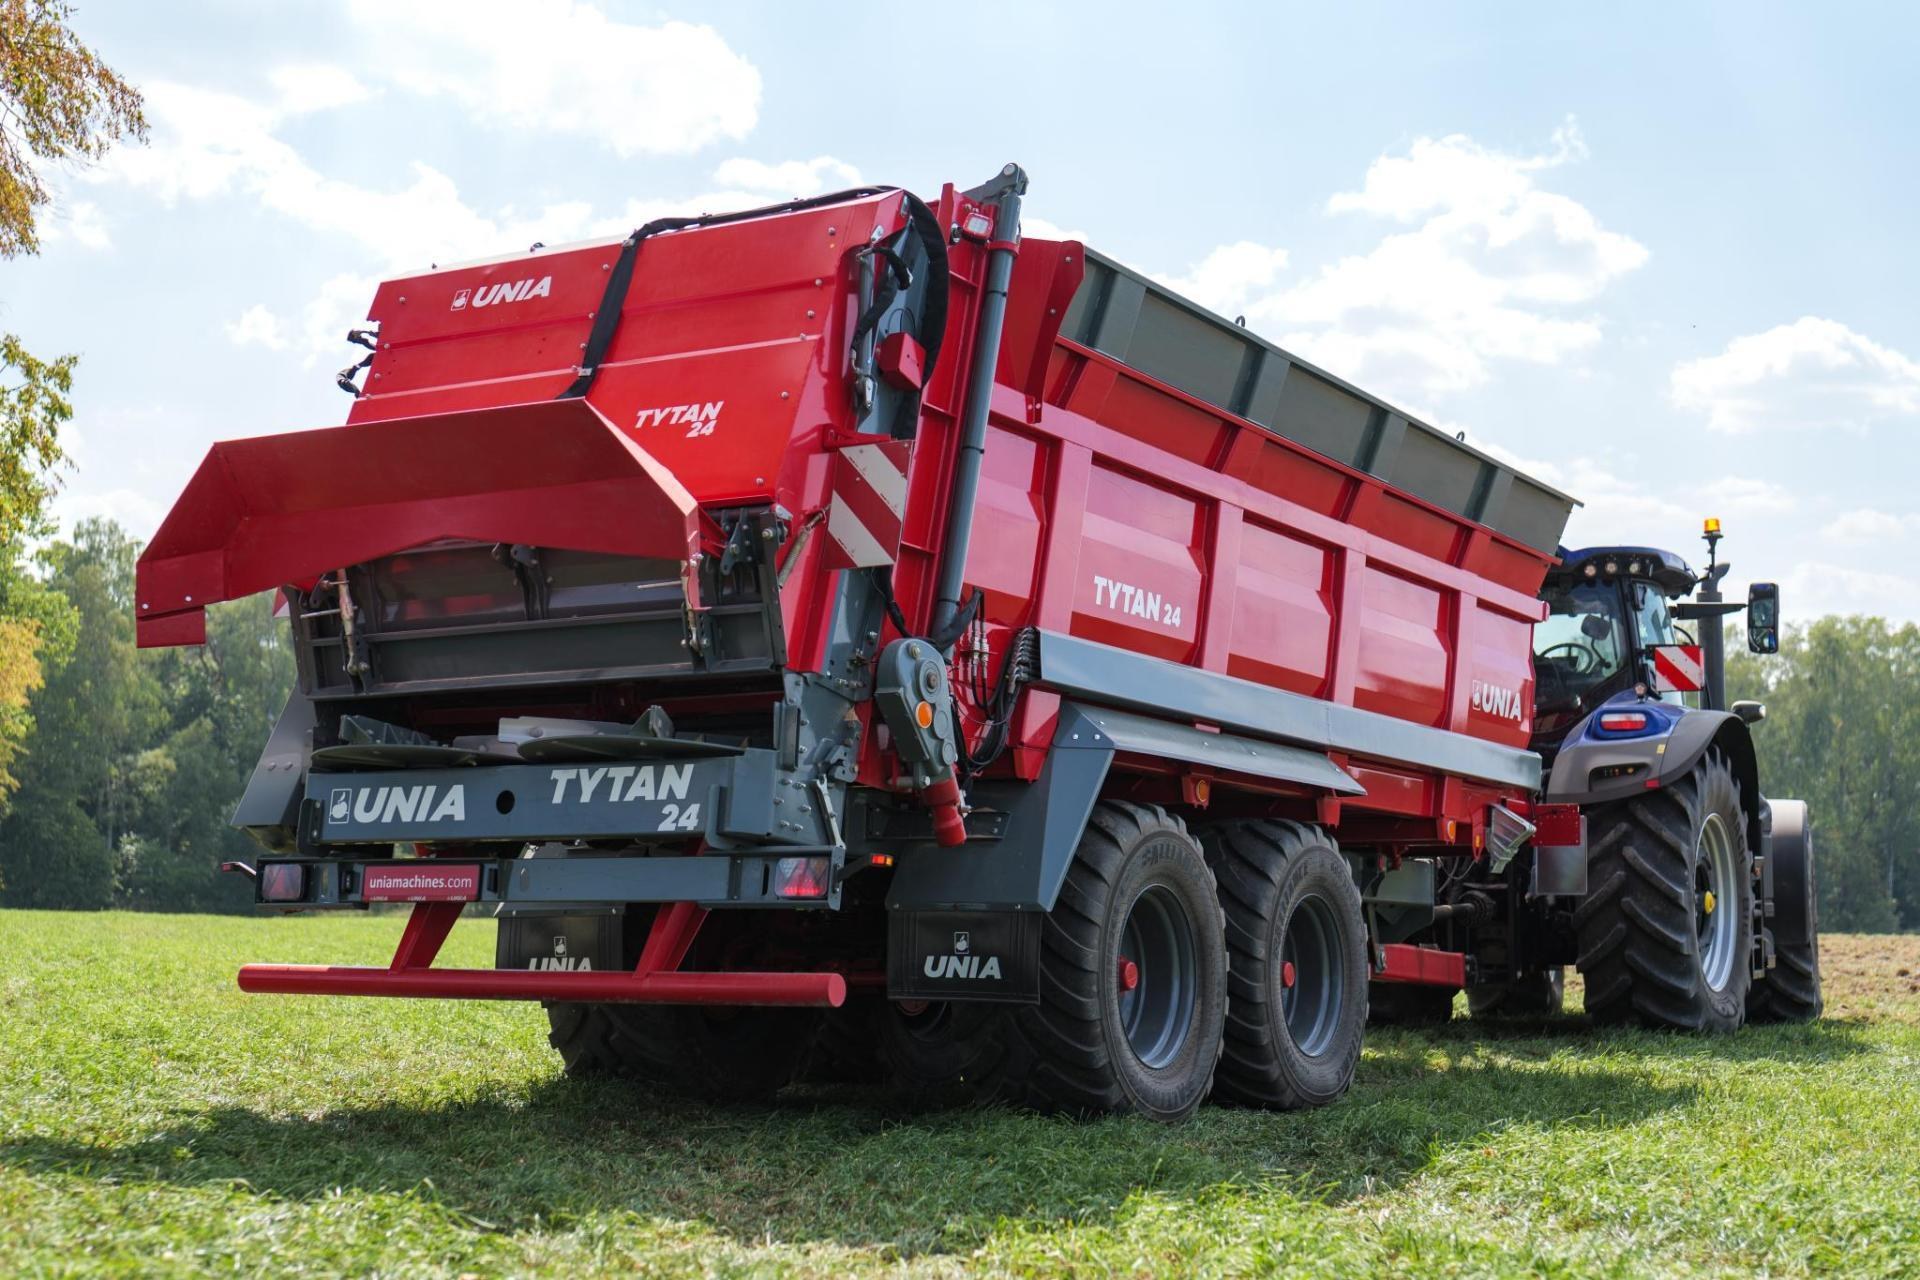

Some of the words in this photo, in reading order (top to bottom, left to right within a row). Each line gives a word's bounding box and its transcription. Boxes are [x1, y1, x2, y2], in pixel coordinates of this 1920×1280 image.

[471, 276, 552, 308] UNIA
[635, 400, 724, 429] TYTAN
[685, 420, 717, 438] 24
[1093, 575, 1161, 622] TYTAN
[1163, 603, 1181, 628] 24
[1482, 683, 1522, 722] UNIA
[550, 763, 695, 804] TYTAN
[353, 784, 466, 824] UNIA
[657, 803, 701, 832] 24
[369, 875, 472, 890] uniamachines.com
[923, 955, 1002, 980] UNIA
